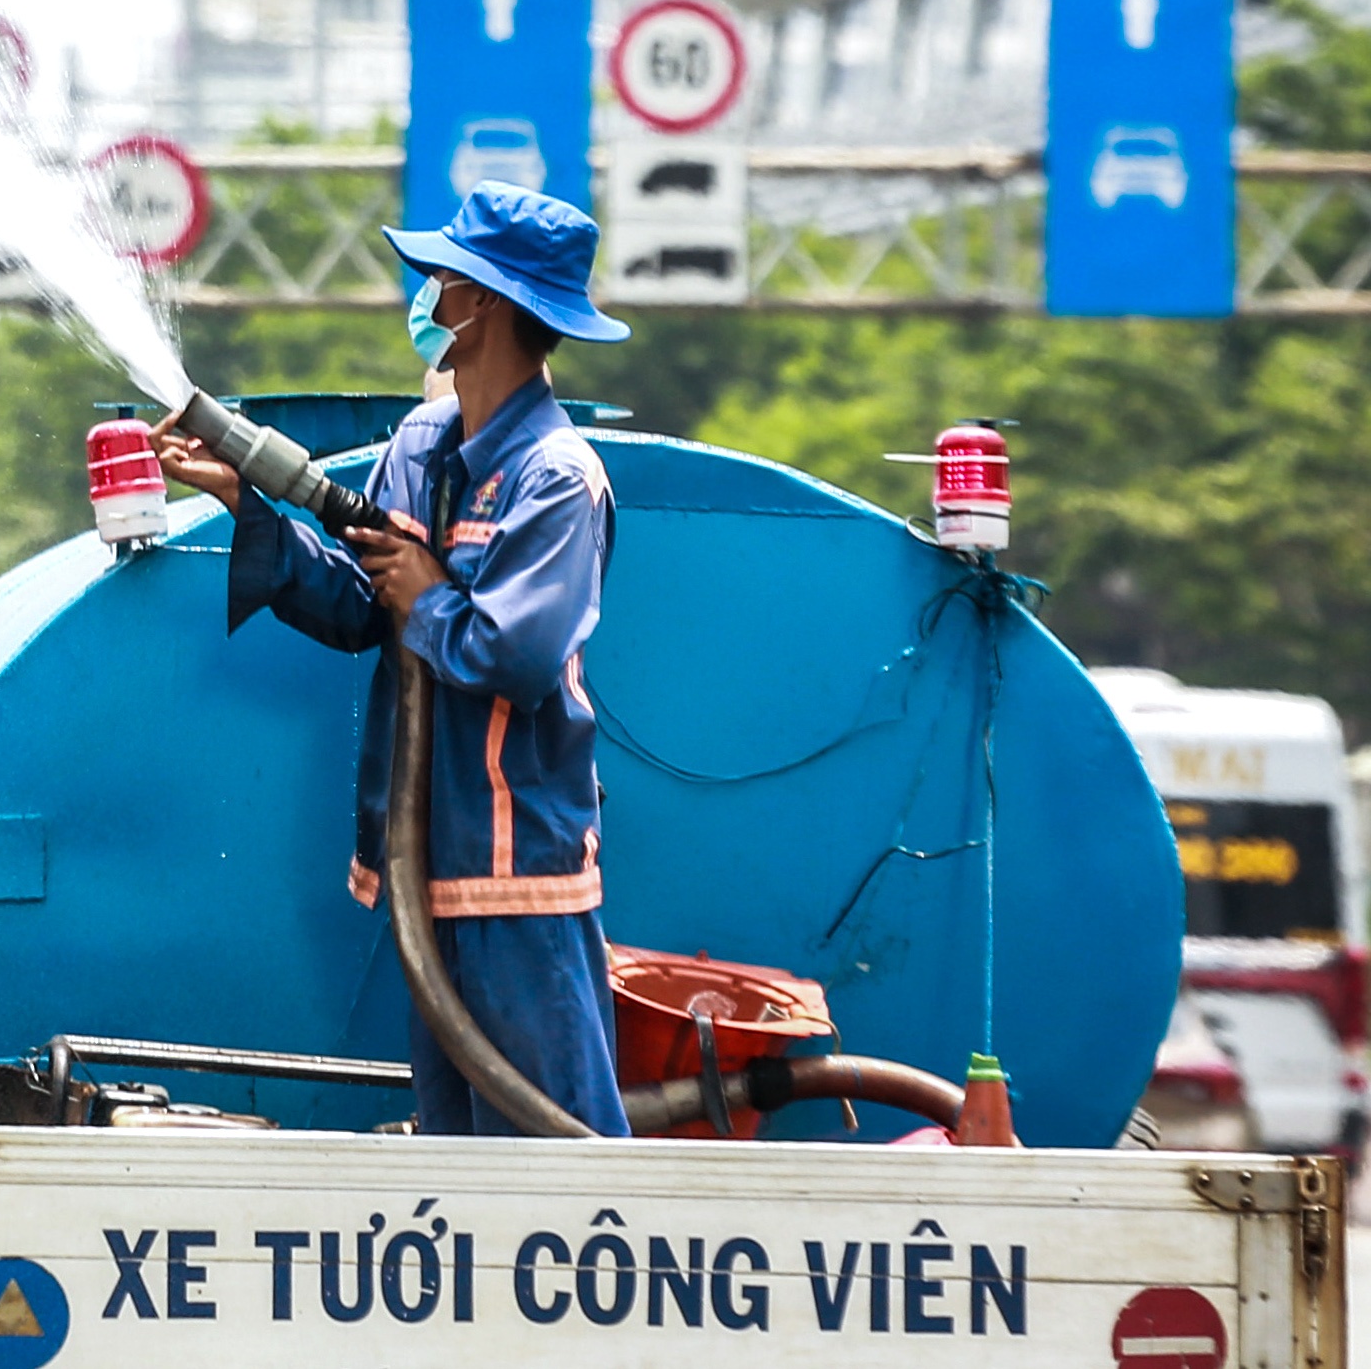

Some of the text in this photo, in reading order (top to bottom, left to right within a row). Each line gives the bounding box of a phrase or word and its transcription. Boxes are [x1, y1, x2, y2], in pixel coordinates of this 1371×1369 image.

[648, 38, 710, 89] 60
[102, 1197, 1028, 1336] XE TƯỚI CÔNG VIÊN
